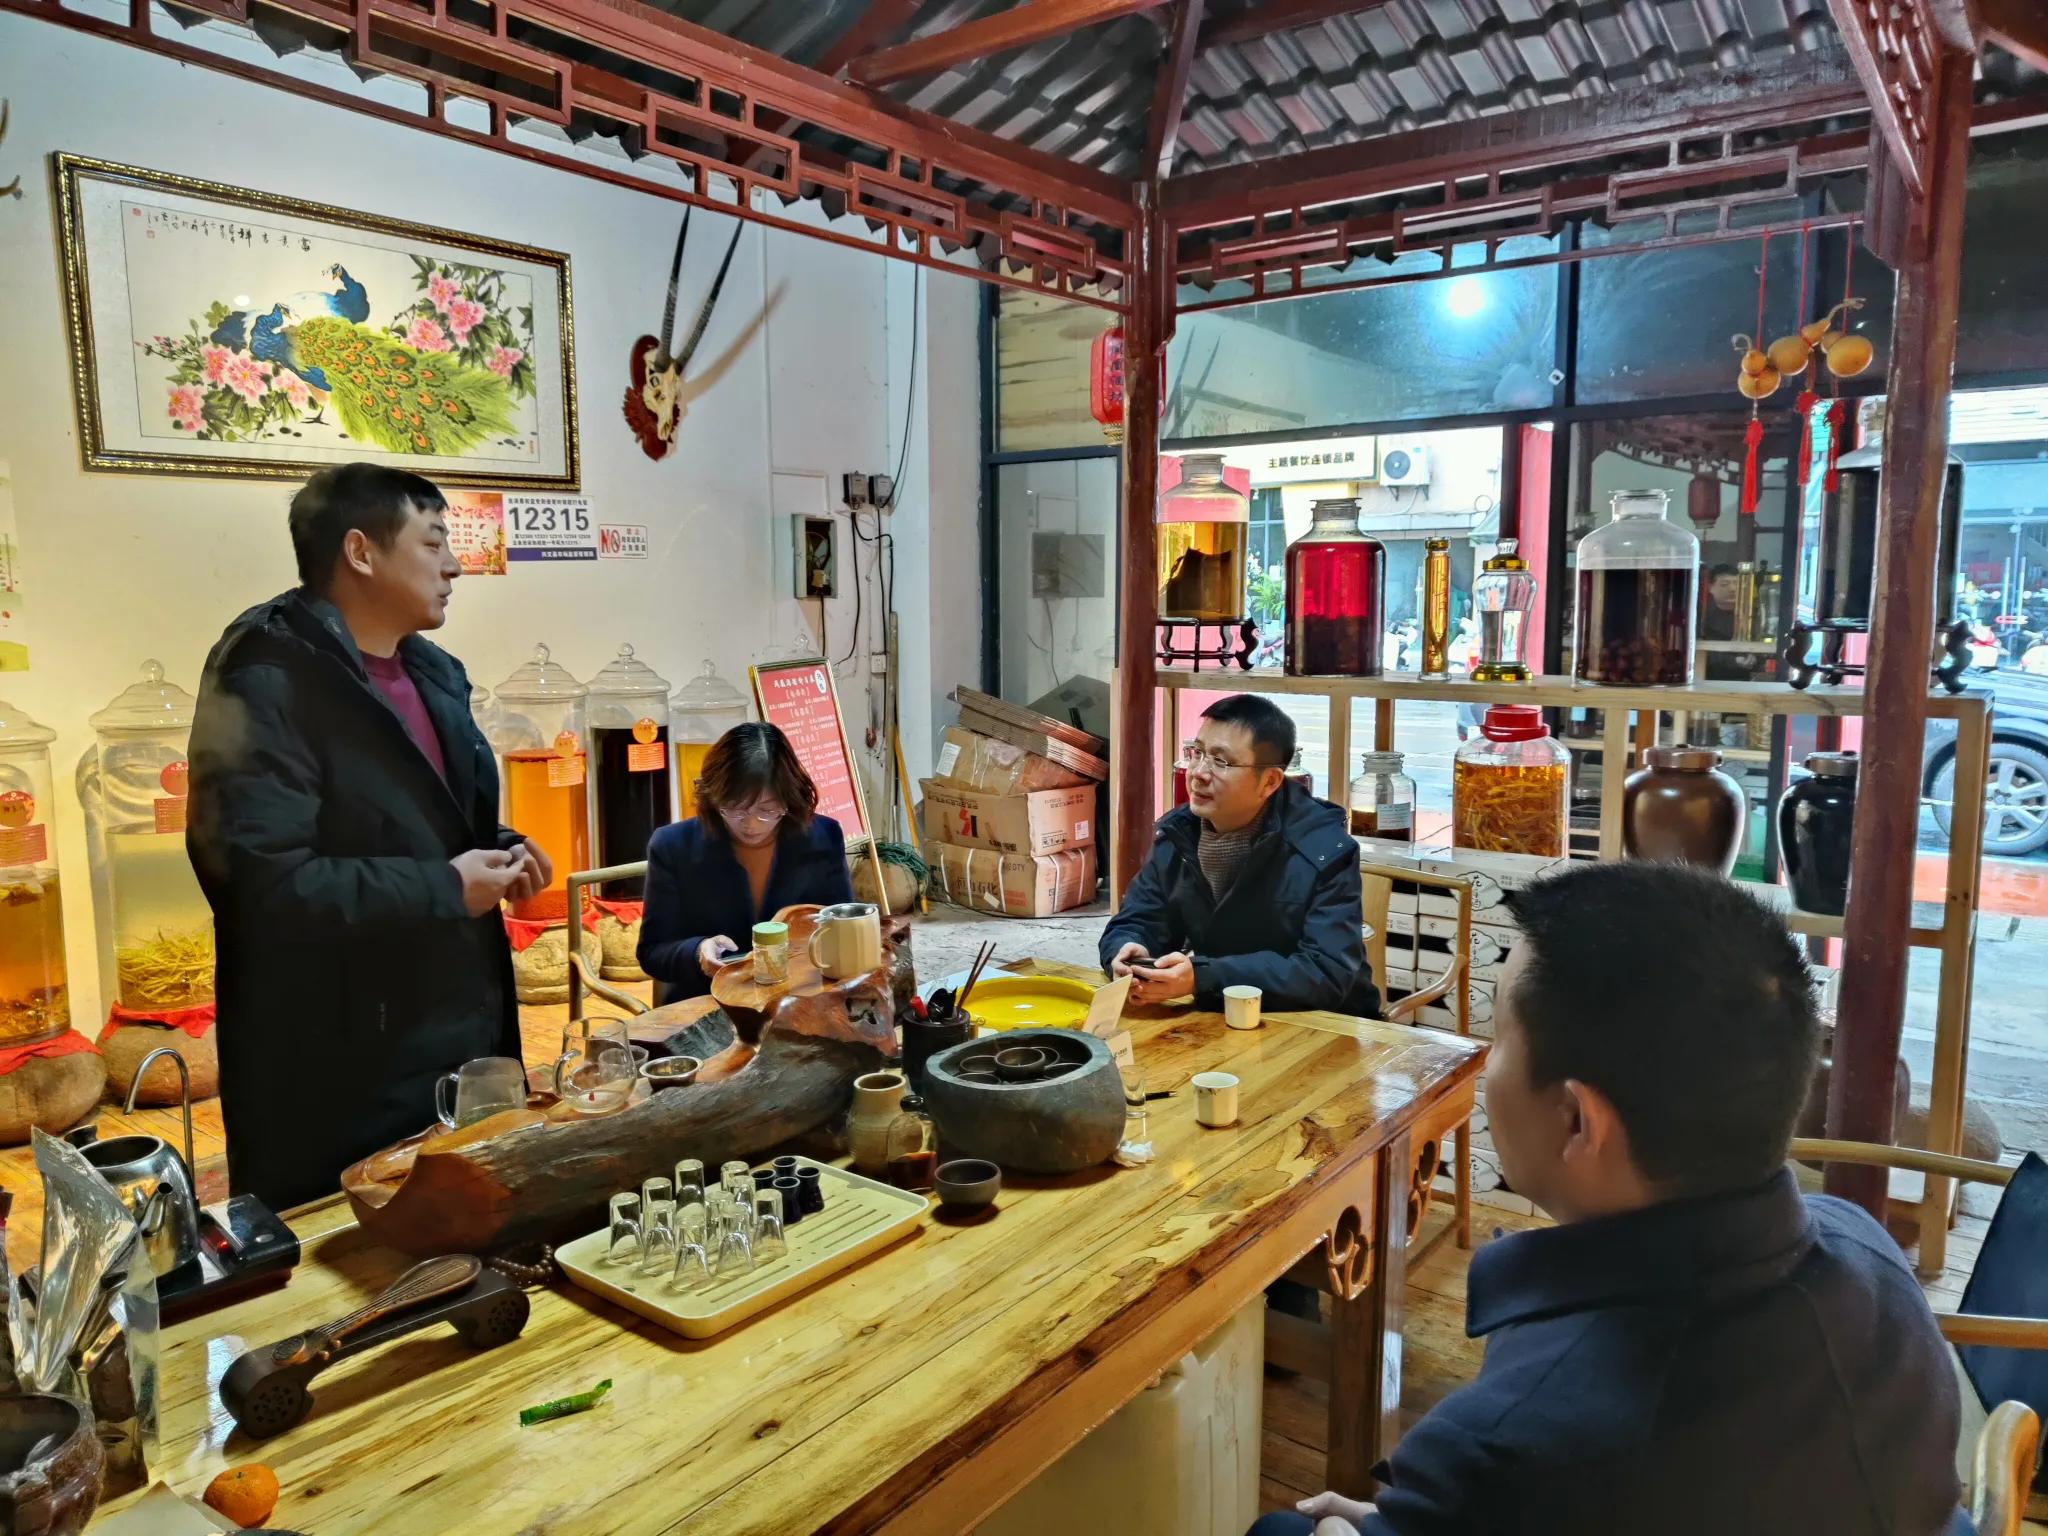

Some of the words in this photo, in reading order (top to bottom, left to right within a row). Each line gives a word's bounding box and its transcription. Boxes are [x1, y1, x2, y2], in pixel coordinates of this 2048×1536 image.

[1269, 452, 1354, 468] 主题餐饮连锁品牌
[508, 507, 589, 531] 12315
